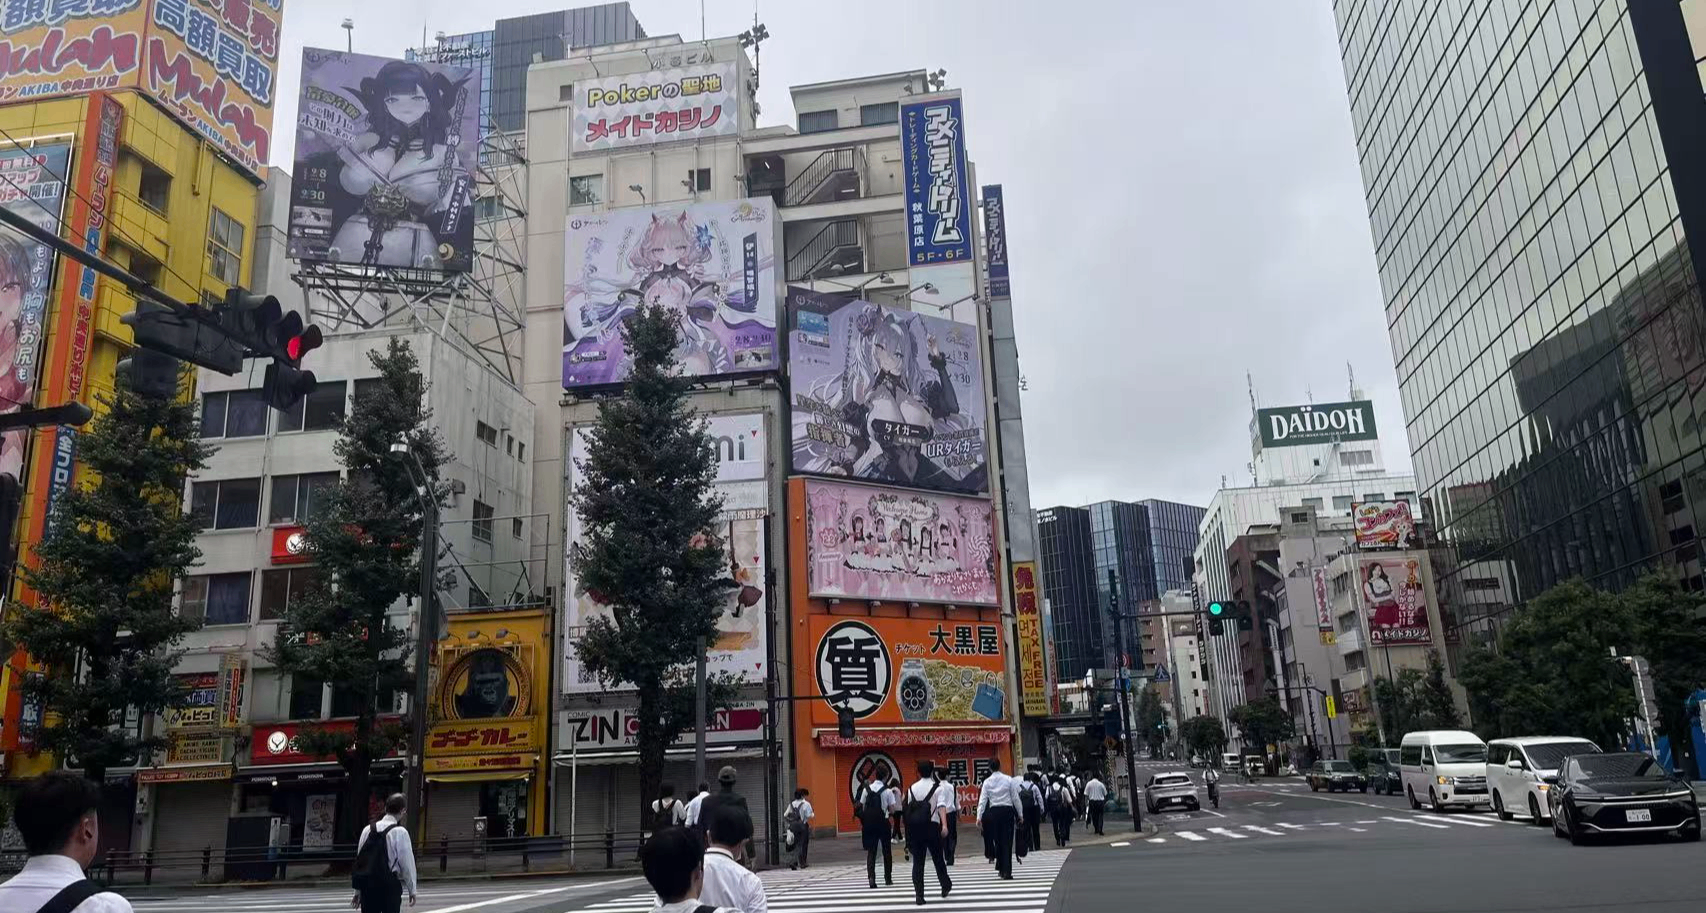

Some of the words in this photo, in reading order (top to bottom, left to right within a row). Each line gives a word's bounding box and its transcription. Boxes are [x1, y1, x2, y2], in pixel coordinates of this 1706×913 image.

[155, 0, 271, 103] 高額買取
[19, 82, 59, 97] AKIBA
[588, 74, 721, 108] Pokerの聖地
[158, 90, 197, 124] ムーラン
[196, 119, 223, 145] AKIBA
[586, 105, 721, 142] メイドカジノ
[912, 202, 924, 247] 秋葉原店
[884, 422, 920, 436] タイガー
[883, 501, 909, 514] Welcome
[908, 503, 929, 517] Home
[895, 642, 927, 655] チケット
[929, 624, 1001, 656] 大黒屋
[1029, 618, 1041, 648] TAX
[1384, 628, 1427, 639] メイドカジノ
[825, 634, 885, 706] 質
[1033, 650, 1044, 689] FREE
[567, 711, 591, 719] COMIC
[567, 709, 620, 746] ZIN
